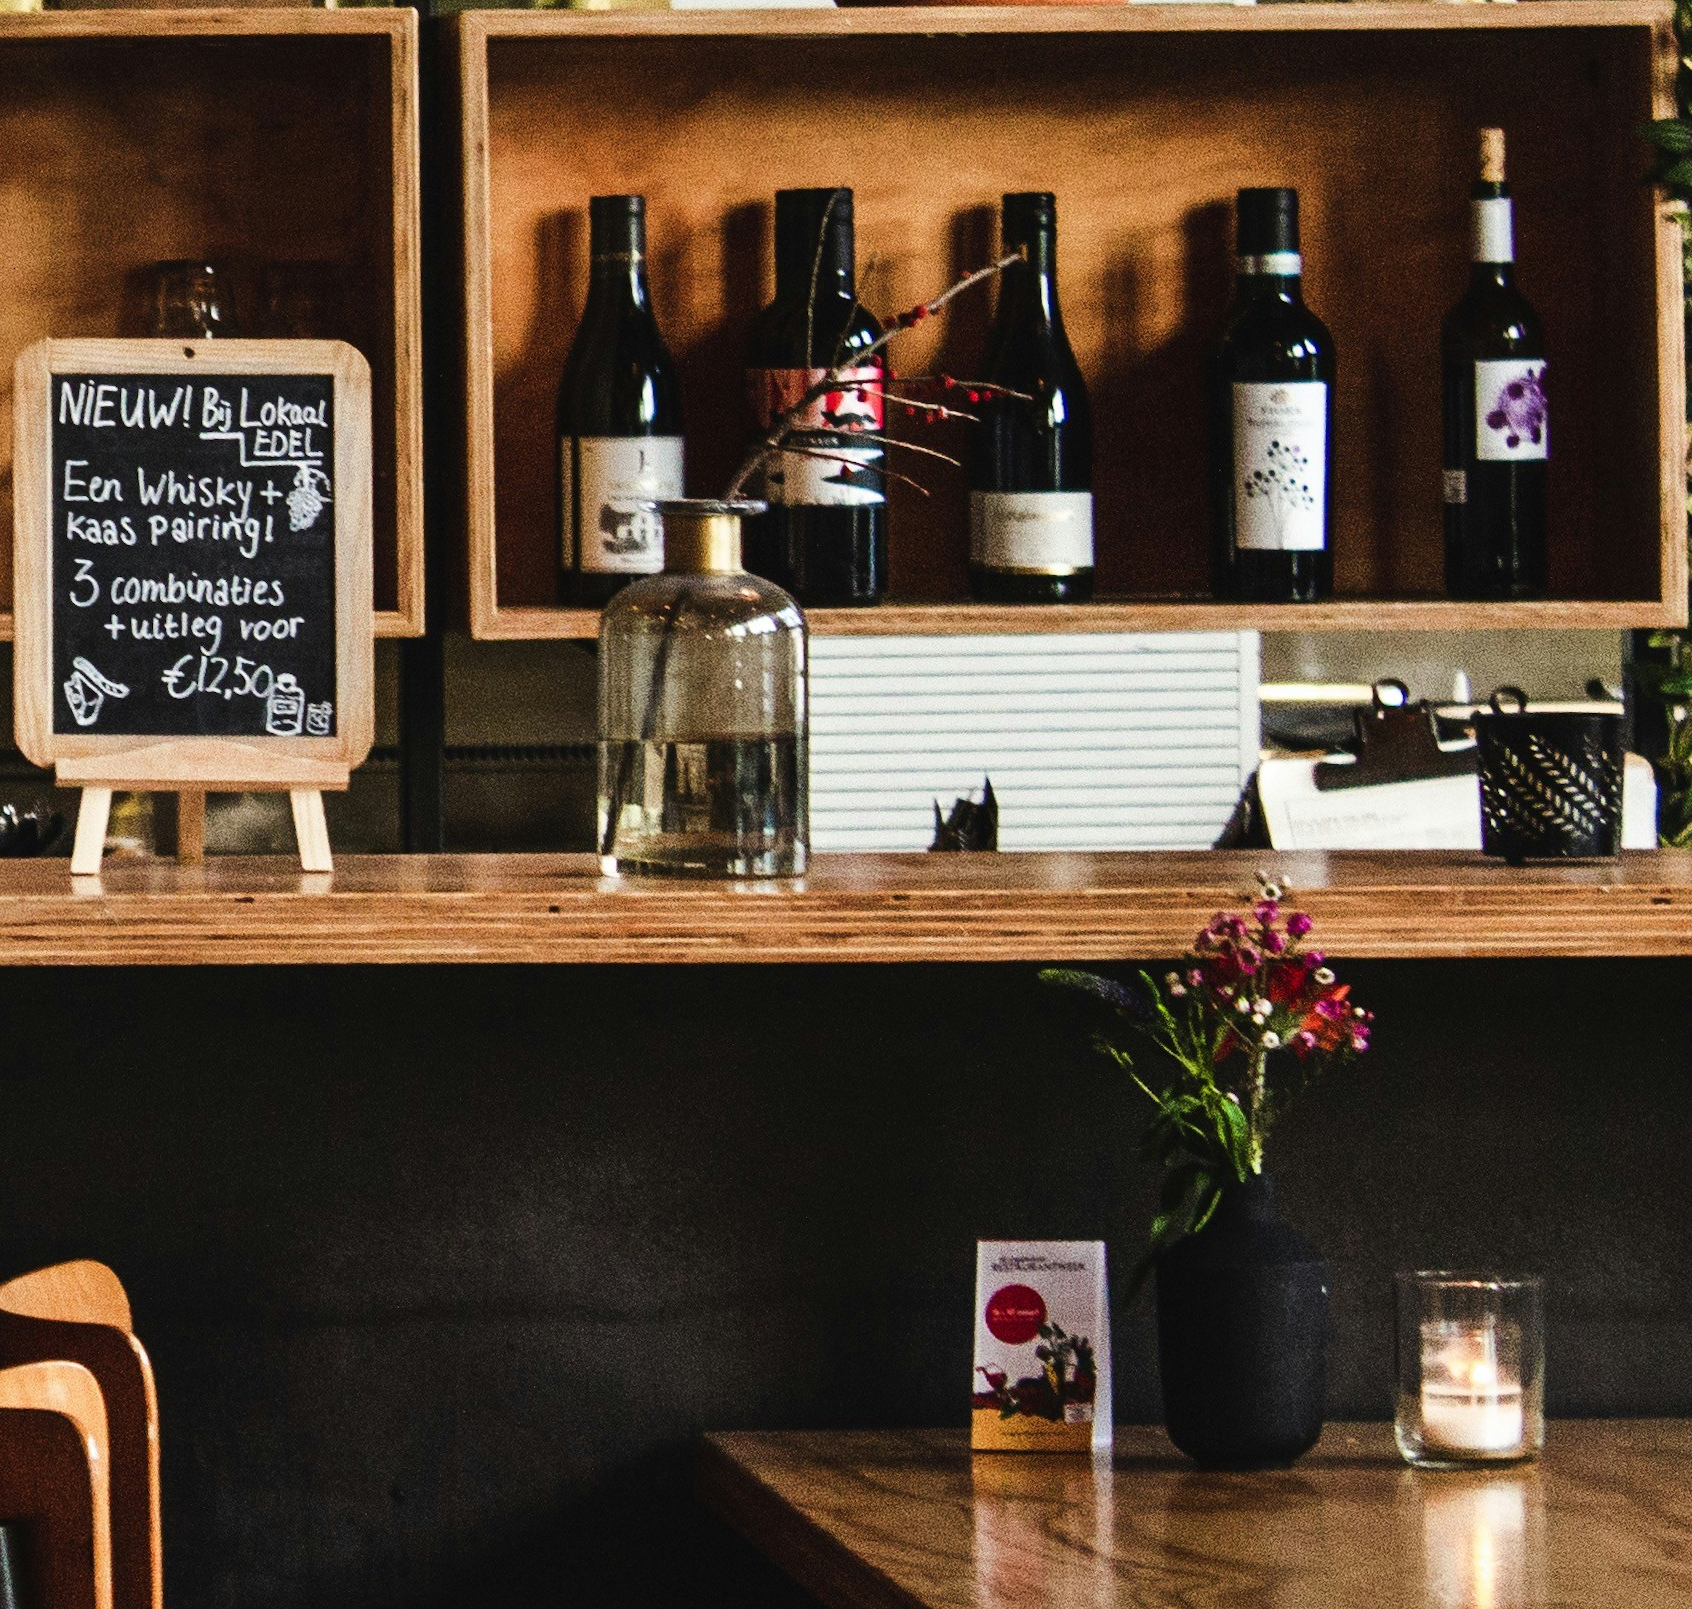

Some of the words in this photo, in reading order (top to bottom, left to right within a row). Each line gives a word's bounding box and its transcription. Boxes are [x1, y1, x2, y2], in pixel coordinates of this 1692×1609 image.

[239, 387, 328, 428] Lokaal
[253, 428, 324, 458] EDEL
[64, 460, 123, 503] Een
[69, 558, 100, 607] 3
[110, 571, 285, 607] combinaties
[239, 616, 305, 641] voor
[160, 654, 275, 701] €12,50
